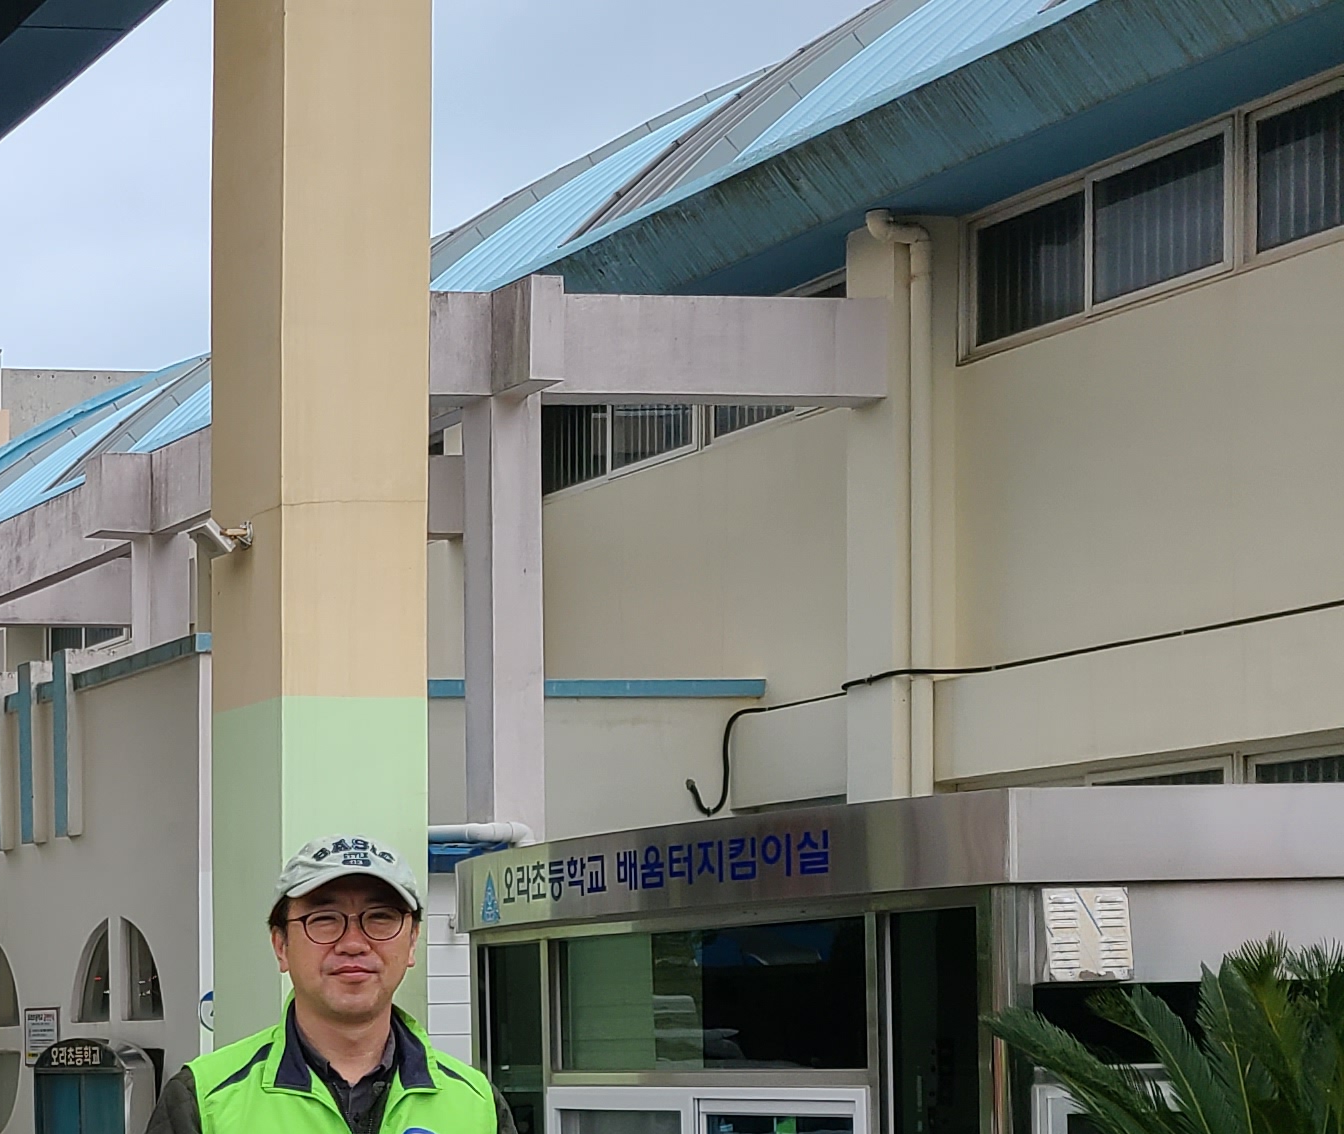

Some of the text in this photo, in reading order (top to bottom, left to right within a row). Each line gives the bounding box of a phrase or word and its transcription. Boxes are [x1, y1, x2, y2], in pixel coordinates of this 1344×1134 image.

[312, 838, 396, 865] BASIC
[502, 829, 830, 905] 오라초등학교 배움터지킴이실
